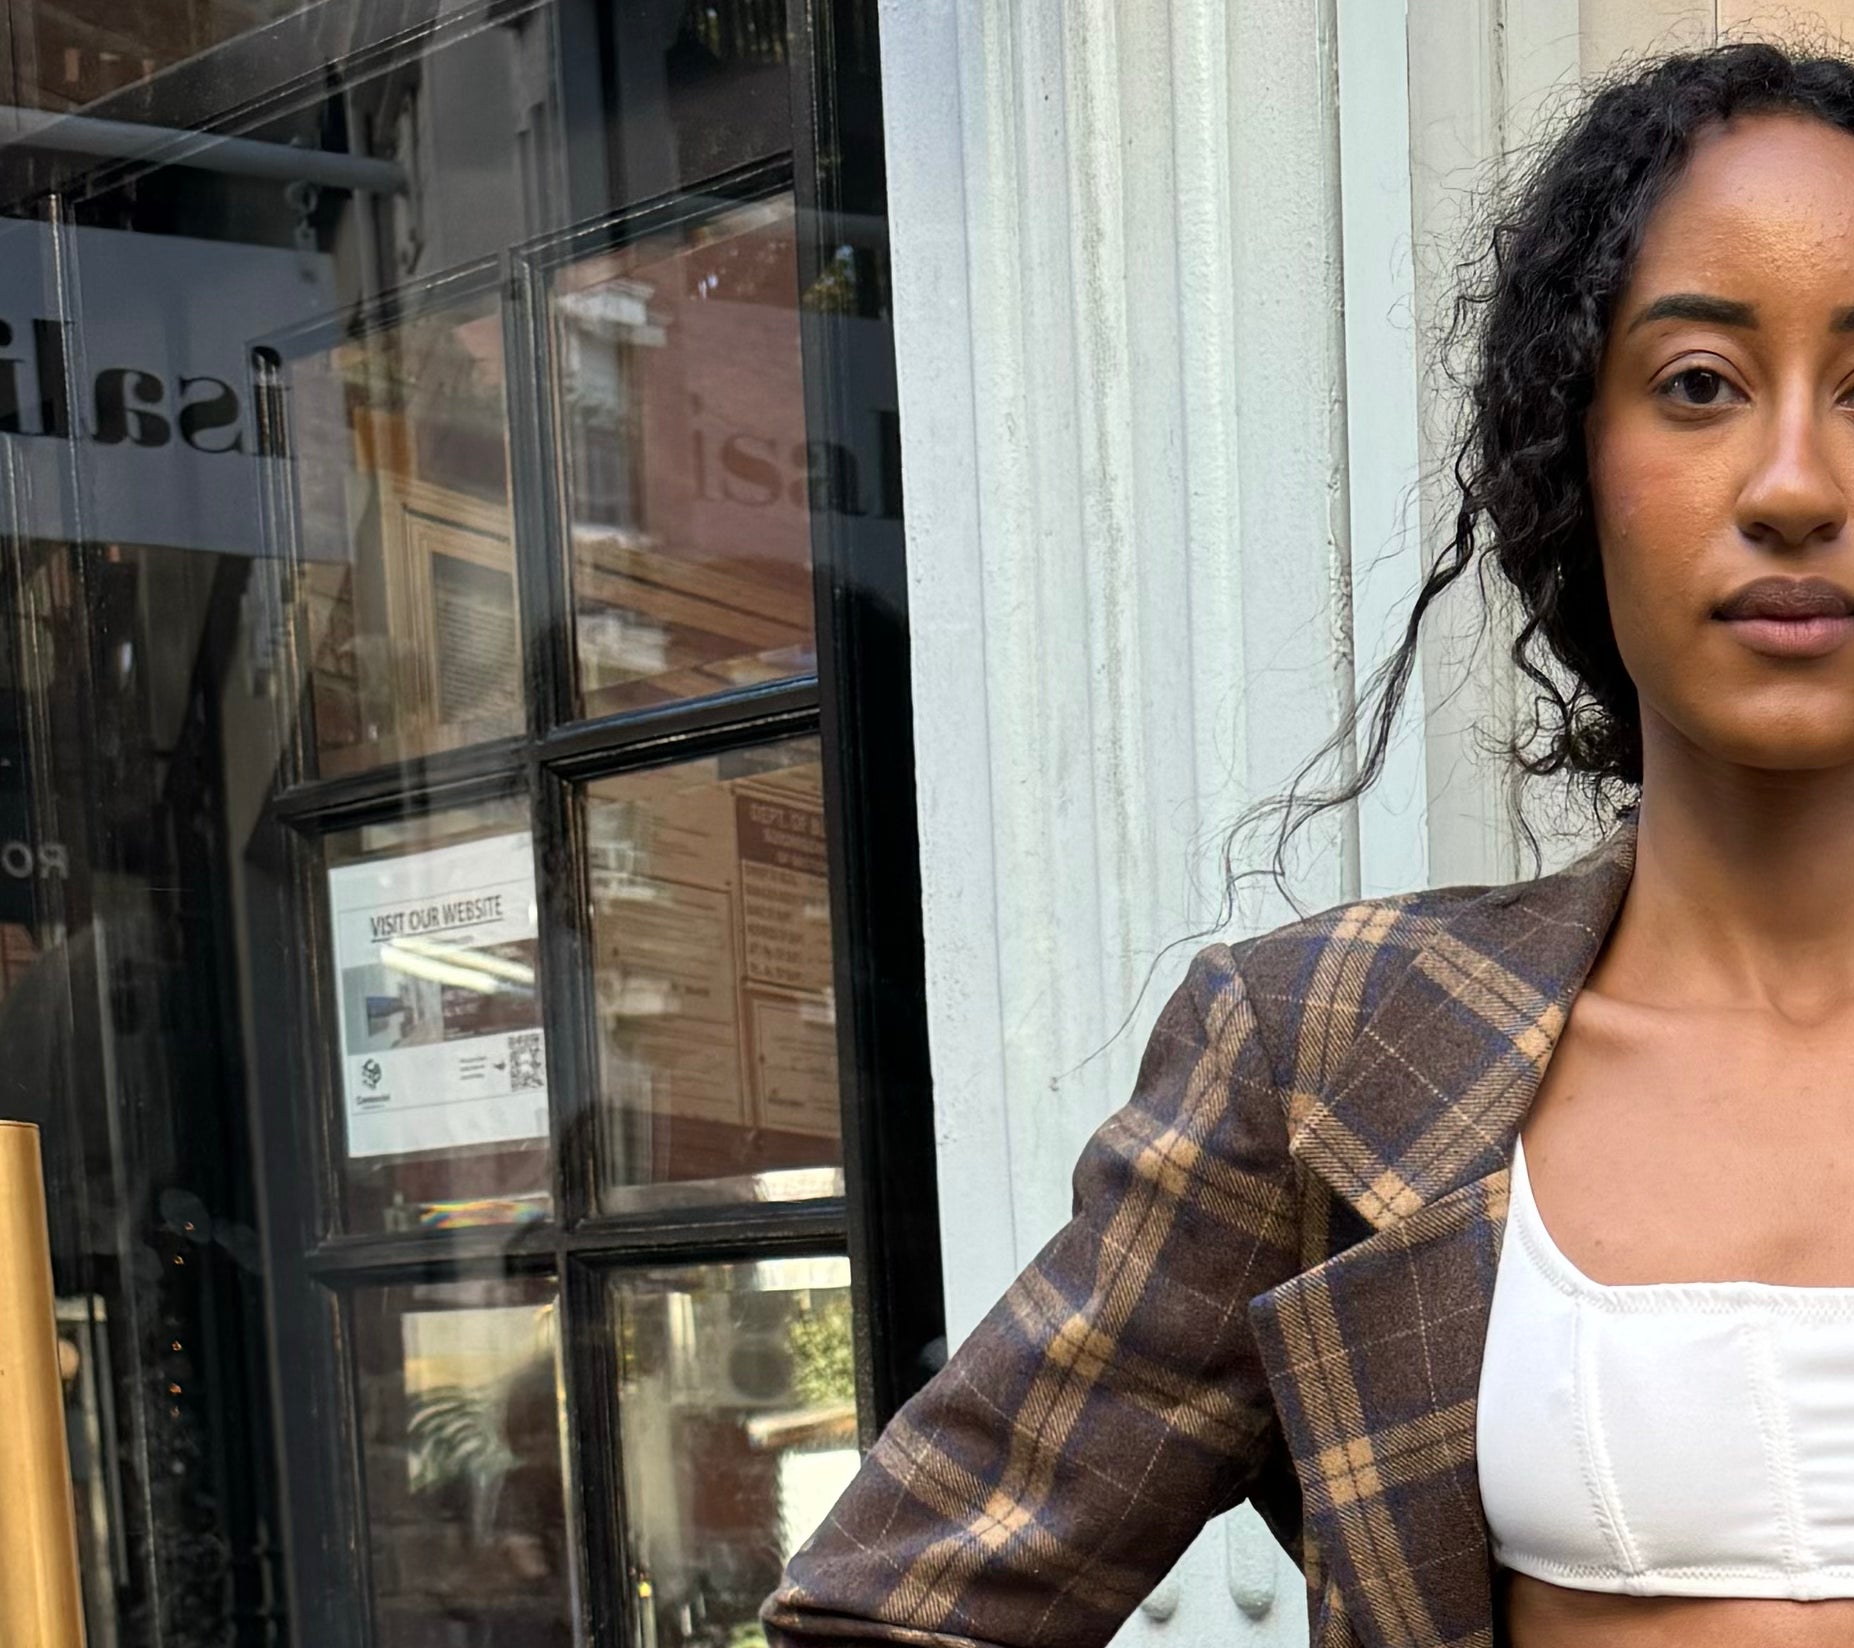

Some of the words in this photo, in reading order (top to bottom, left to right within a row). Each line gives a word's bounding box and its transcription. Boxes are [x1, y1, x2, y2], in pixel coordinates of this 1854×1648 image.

[370, 911, 405, 938] VISIT
[408, 905, 440, 931] OUR
[442, 894, 503, 925] WEBSITE
